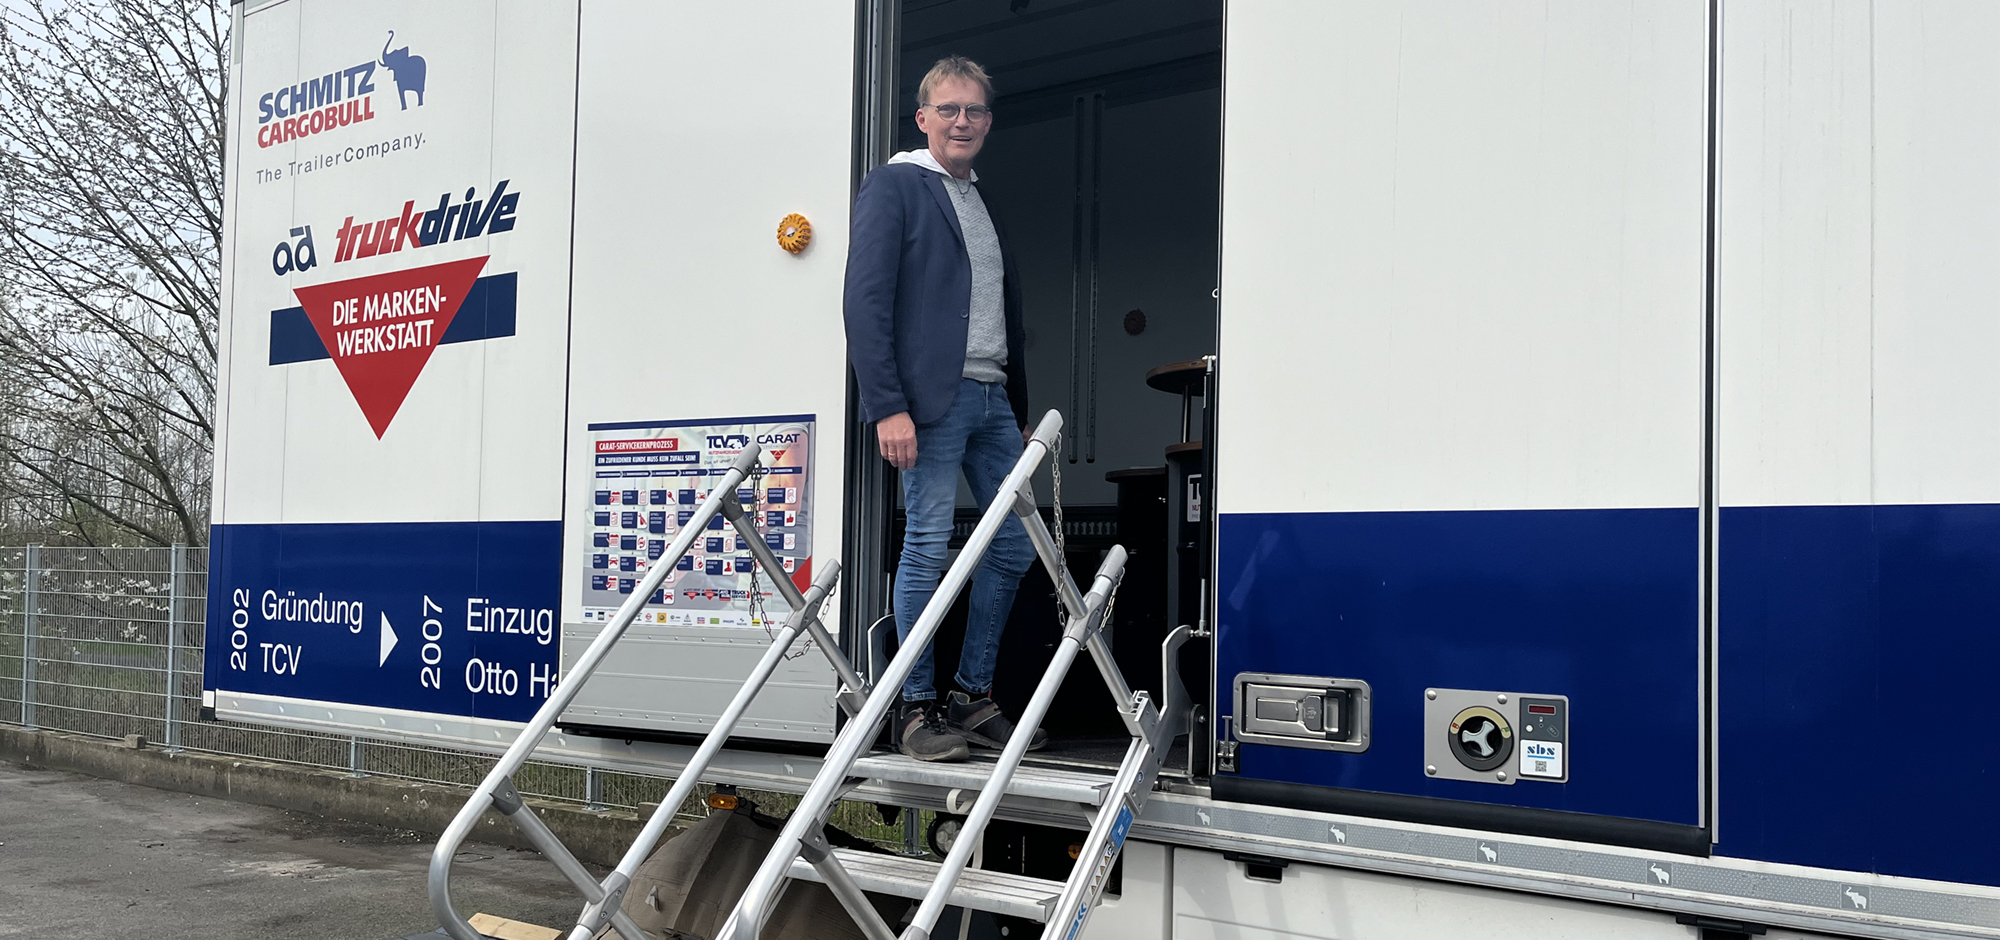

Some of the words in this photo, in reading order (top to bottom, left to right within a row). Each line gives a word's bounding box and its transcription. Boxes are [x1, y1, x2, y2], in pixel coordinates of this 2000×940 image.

[258, 60, 377, 124] SCHMITZ
[257, 95, 375, 149] CARGOBULL
[256, 166, 282, 185] The
[332, 299, 359, 328] DIE
[362, 284, 448, 323] MARKEN-
[336, 319, 435, 359] WERKSTATT
[598, 440, 674, 451] CARAT-SERVICEKERNPROZESS
[706, 435, 729, 449] TCV
[756, 433, 800, 444] CARAT
[606, 456, 632, 464] ZUFRIEDENER
[670, 454, 684, 462] ZUFALL
[231, 588, 249, 672] 2002
[261, 589, 363, 634] Gründung
[467, 598, 553, 645] Einzug
[260, 642, 302, 676] TCV
[421, 595, 442, 690] 2007
[465, 657, 518, 695] Otto
[1527, 744, 1555, 756] sbs
